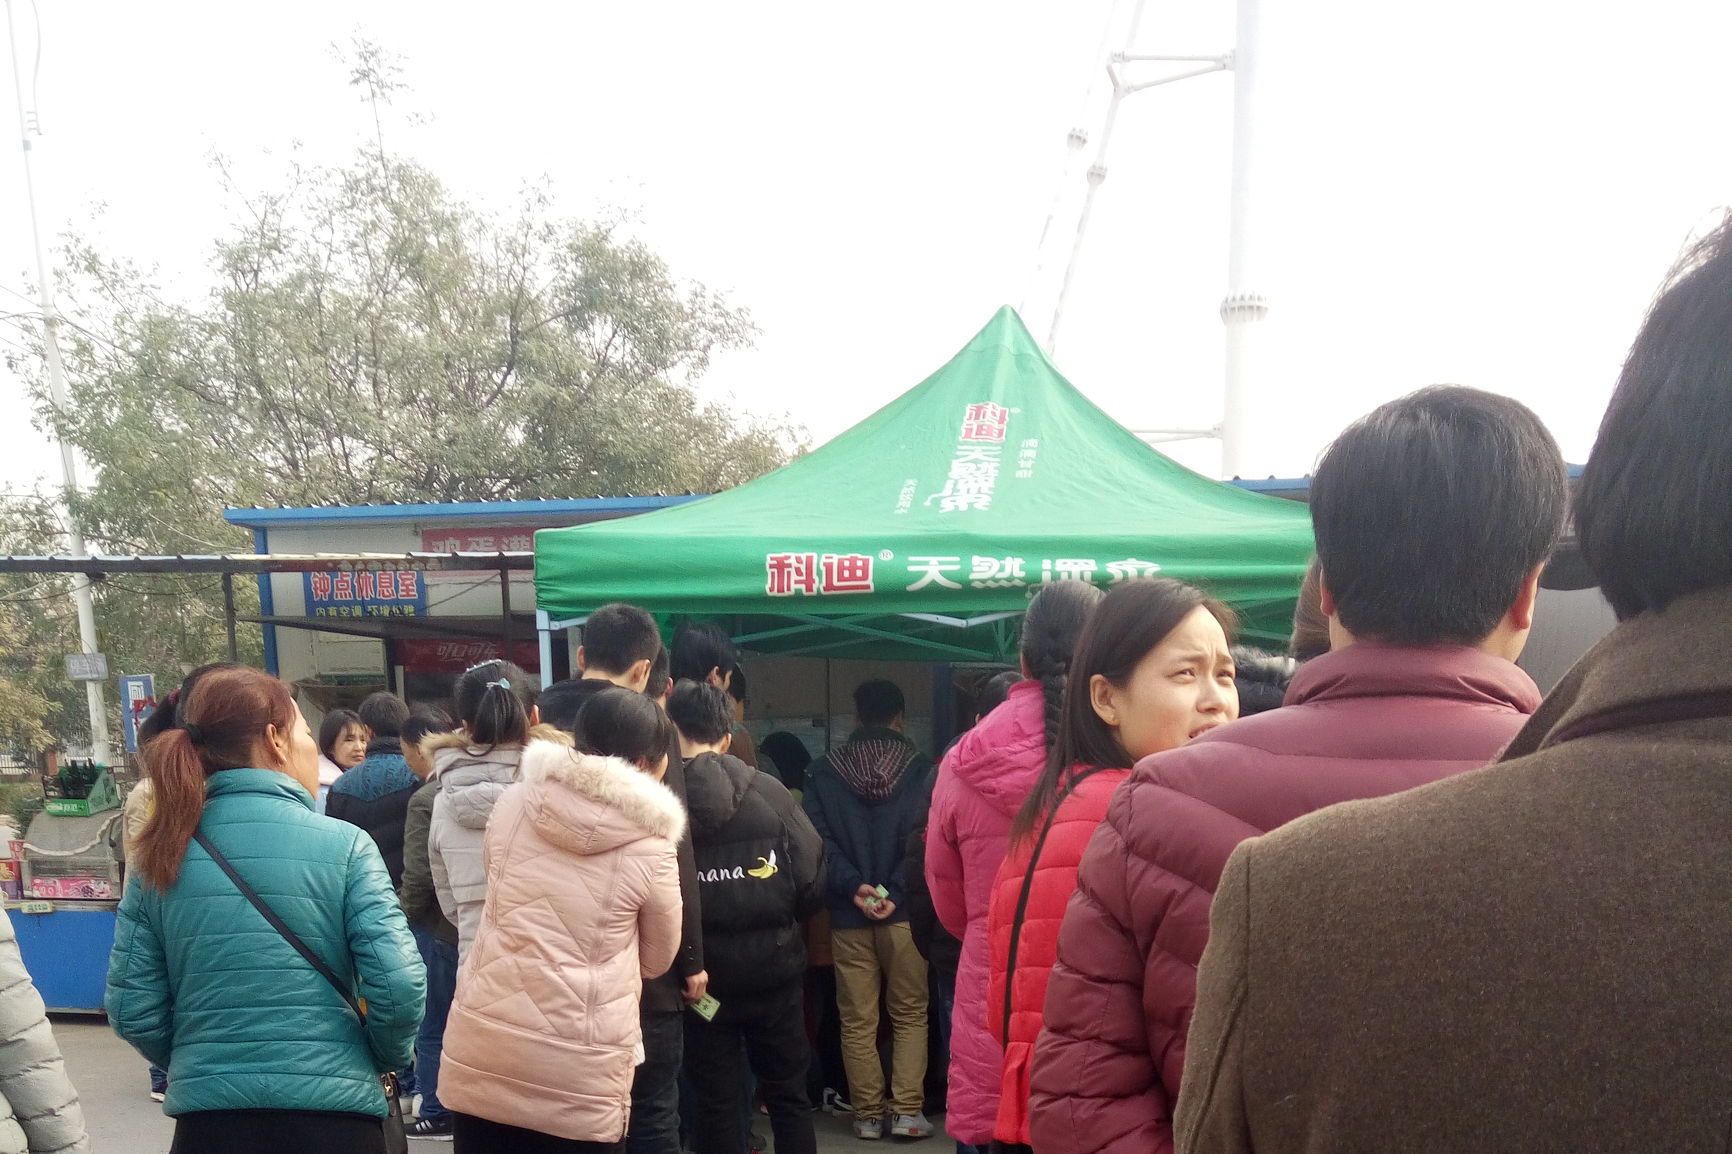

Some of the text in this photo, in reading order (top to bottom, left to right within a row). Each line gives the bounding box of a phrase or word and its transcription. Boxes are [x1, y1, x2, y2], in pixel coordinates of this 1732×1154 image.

[959, 402, 1009, 443] 科迪
[310, 570, 418, 601] 钟点休息室
[765, 551, 874, 597] 科迪
